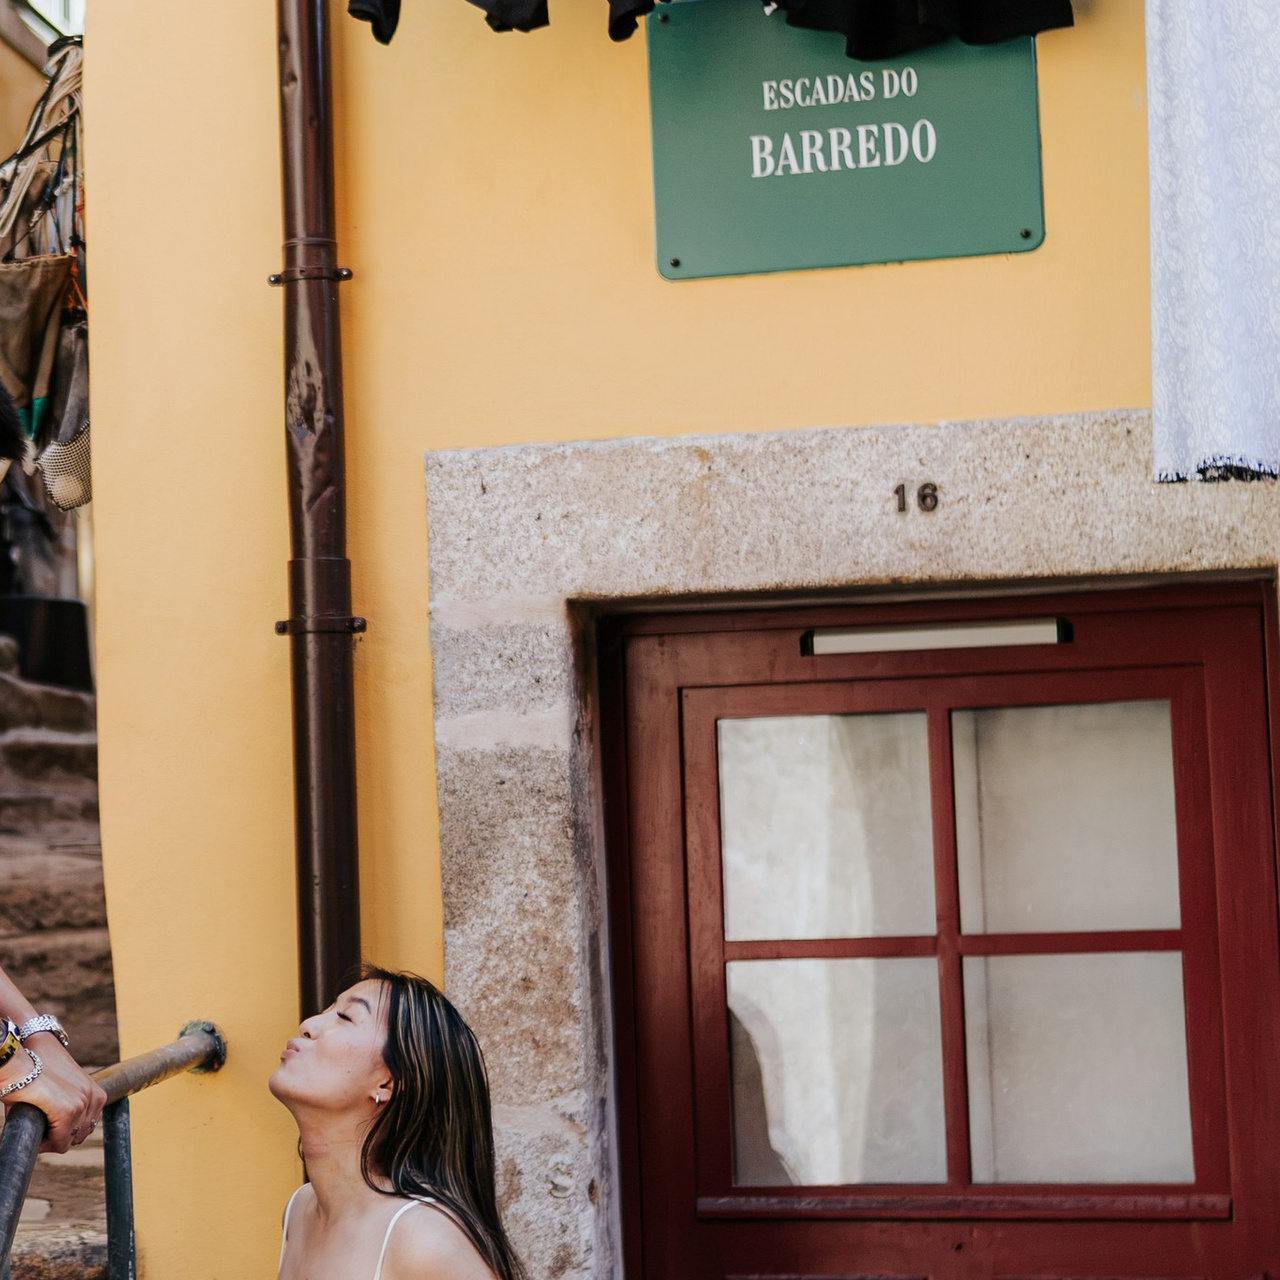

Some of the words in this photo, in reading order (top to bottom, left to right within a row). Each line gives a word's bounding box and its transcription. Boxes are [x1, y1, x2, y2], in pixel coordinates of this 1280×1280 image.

[762, 71, 876, 110] ESCADAS
[882, 66, 918, 99] DO
[750, 119, 937, 178] BARREDO
[893, 482, 938, 513] 16
